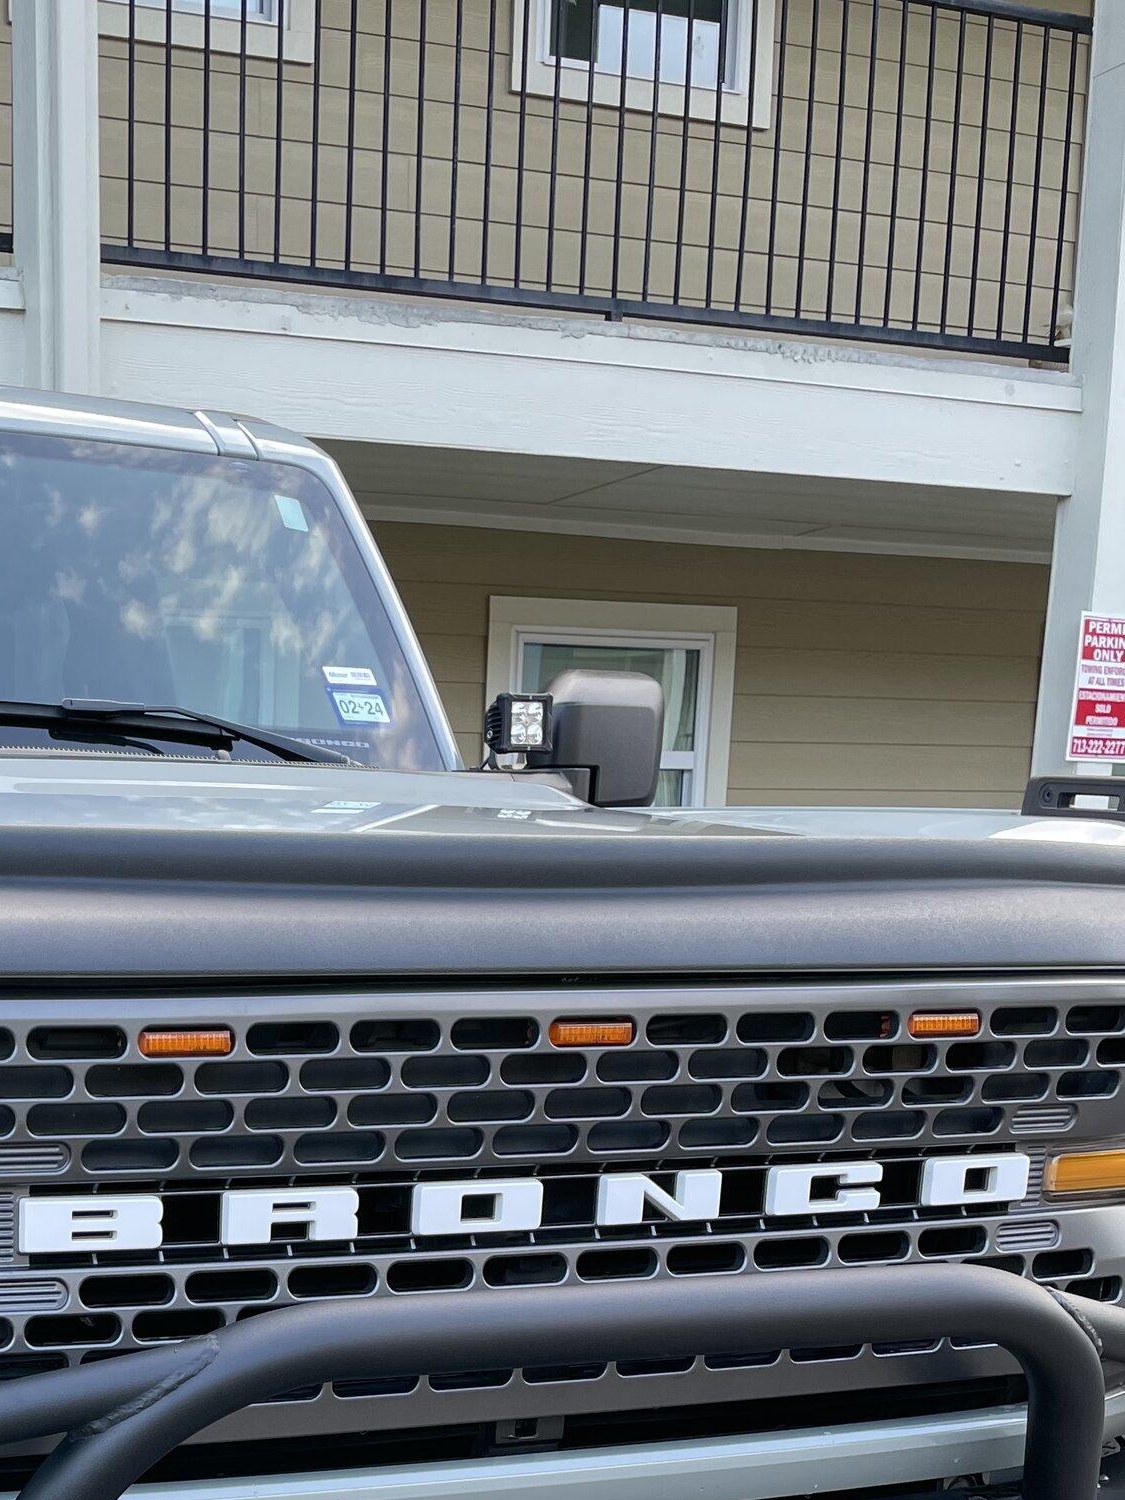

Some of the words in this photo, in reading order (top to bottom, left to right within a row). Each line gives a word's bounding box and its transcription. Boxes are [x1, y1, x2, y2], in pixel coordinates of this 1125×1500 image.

[1088, 621, 1125, 635] PERMI
[1084, 634, 1125, 649] PARKIN
[1093, 648, 1124, 662] ONLY
[1095, 677, 1105, 686] ALL
[17, 1152, 1031, 1254] BRONCO
